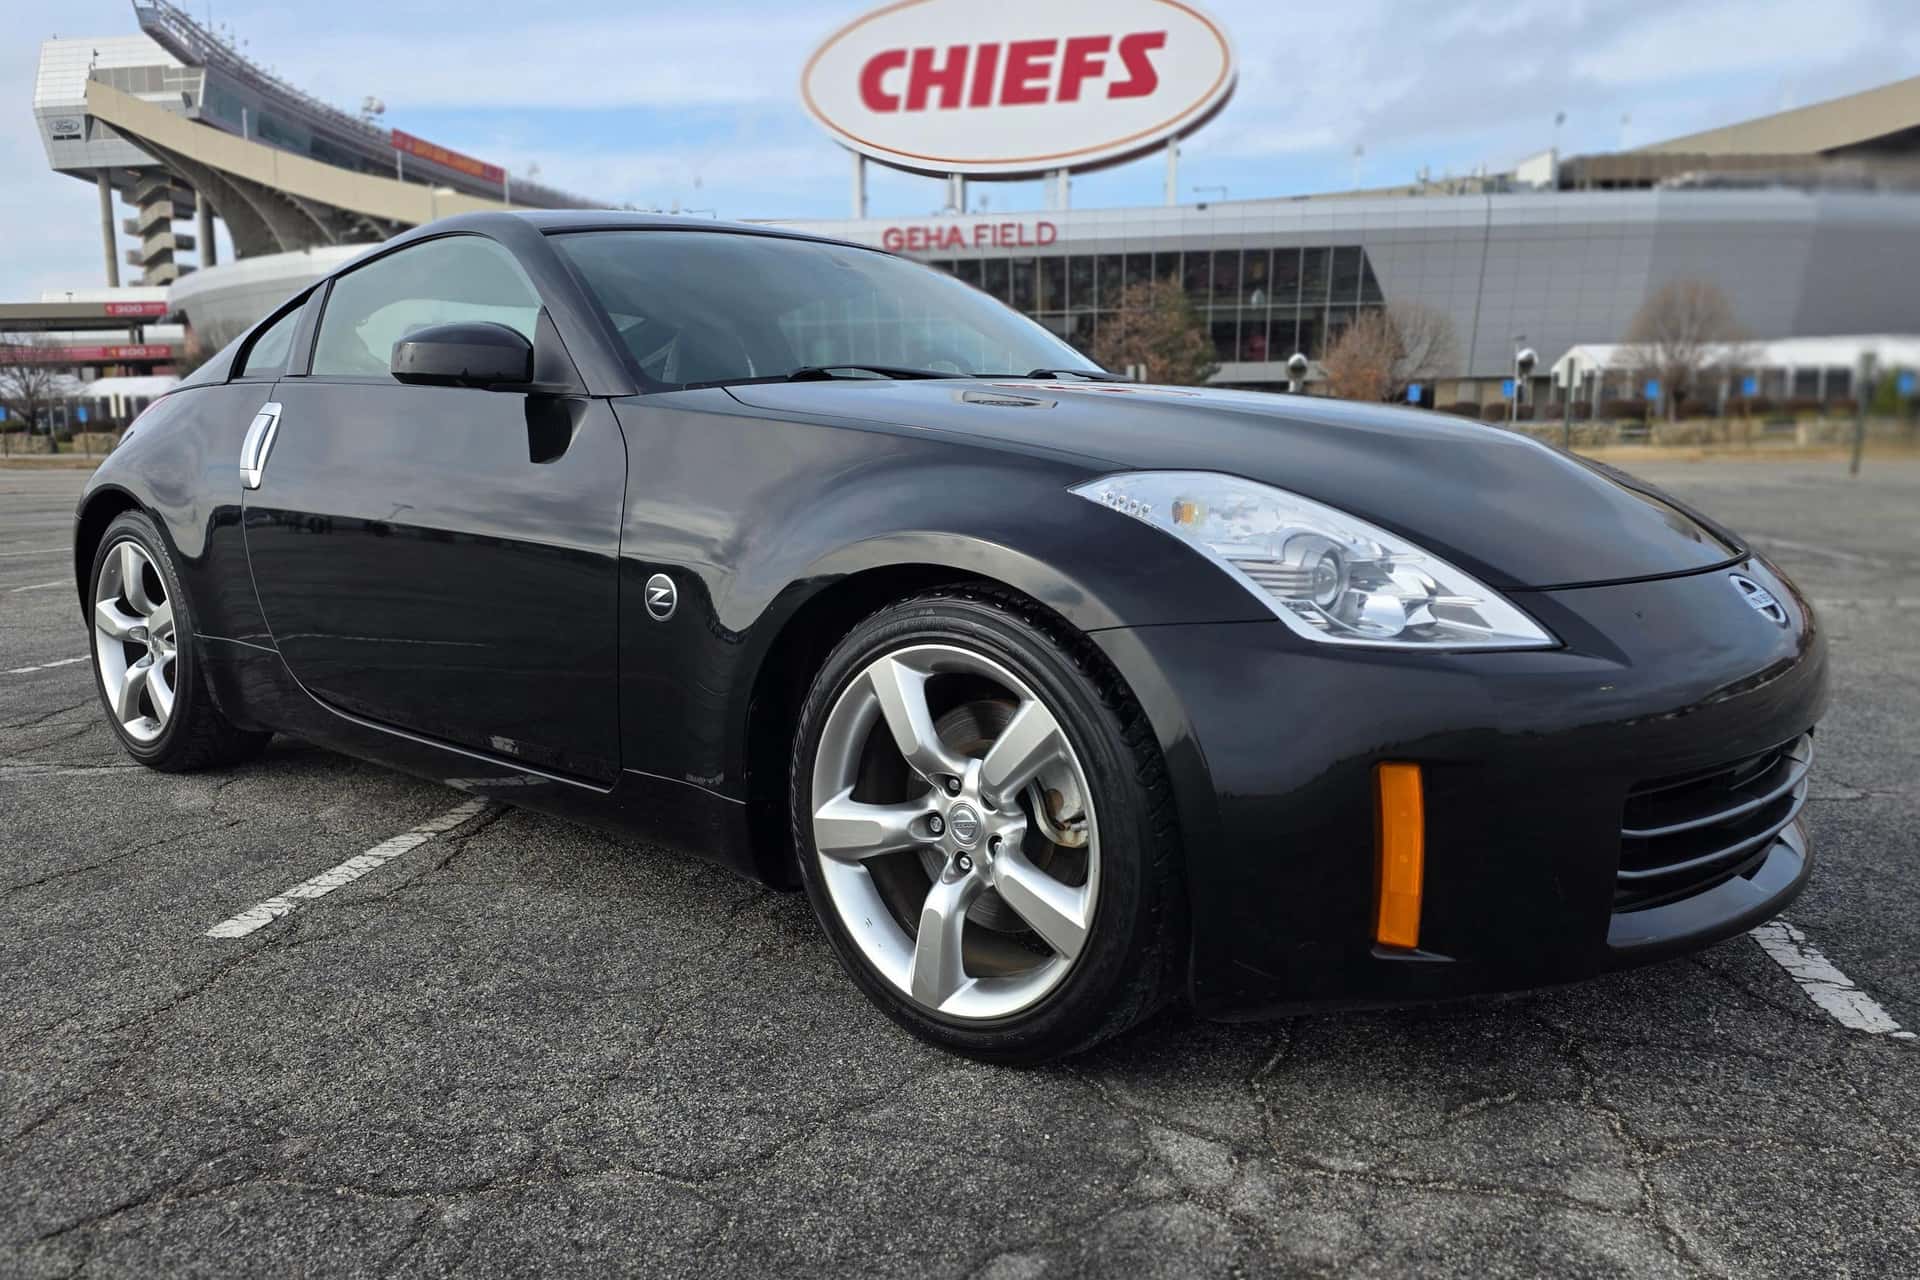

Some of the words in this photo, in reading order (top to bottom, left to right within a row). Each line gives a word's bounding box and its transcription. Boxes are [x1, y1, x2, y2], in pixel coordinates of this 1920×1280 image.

[859, 31, 1167, 113] CHIEFS
[883, 224, 967, 252] GEHA
[973, 222, 1057, 249] FIELD
[648, 587, 673, 606] Z
